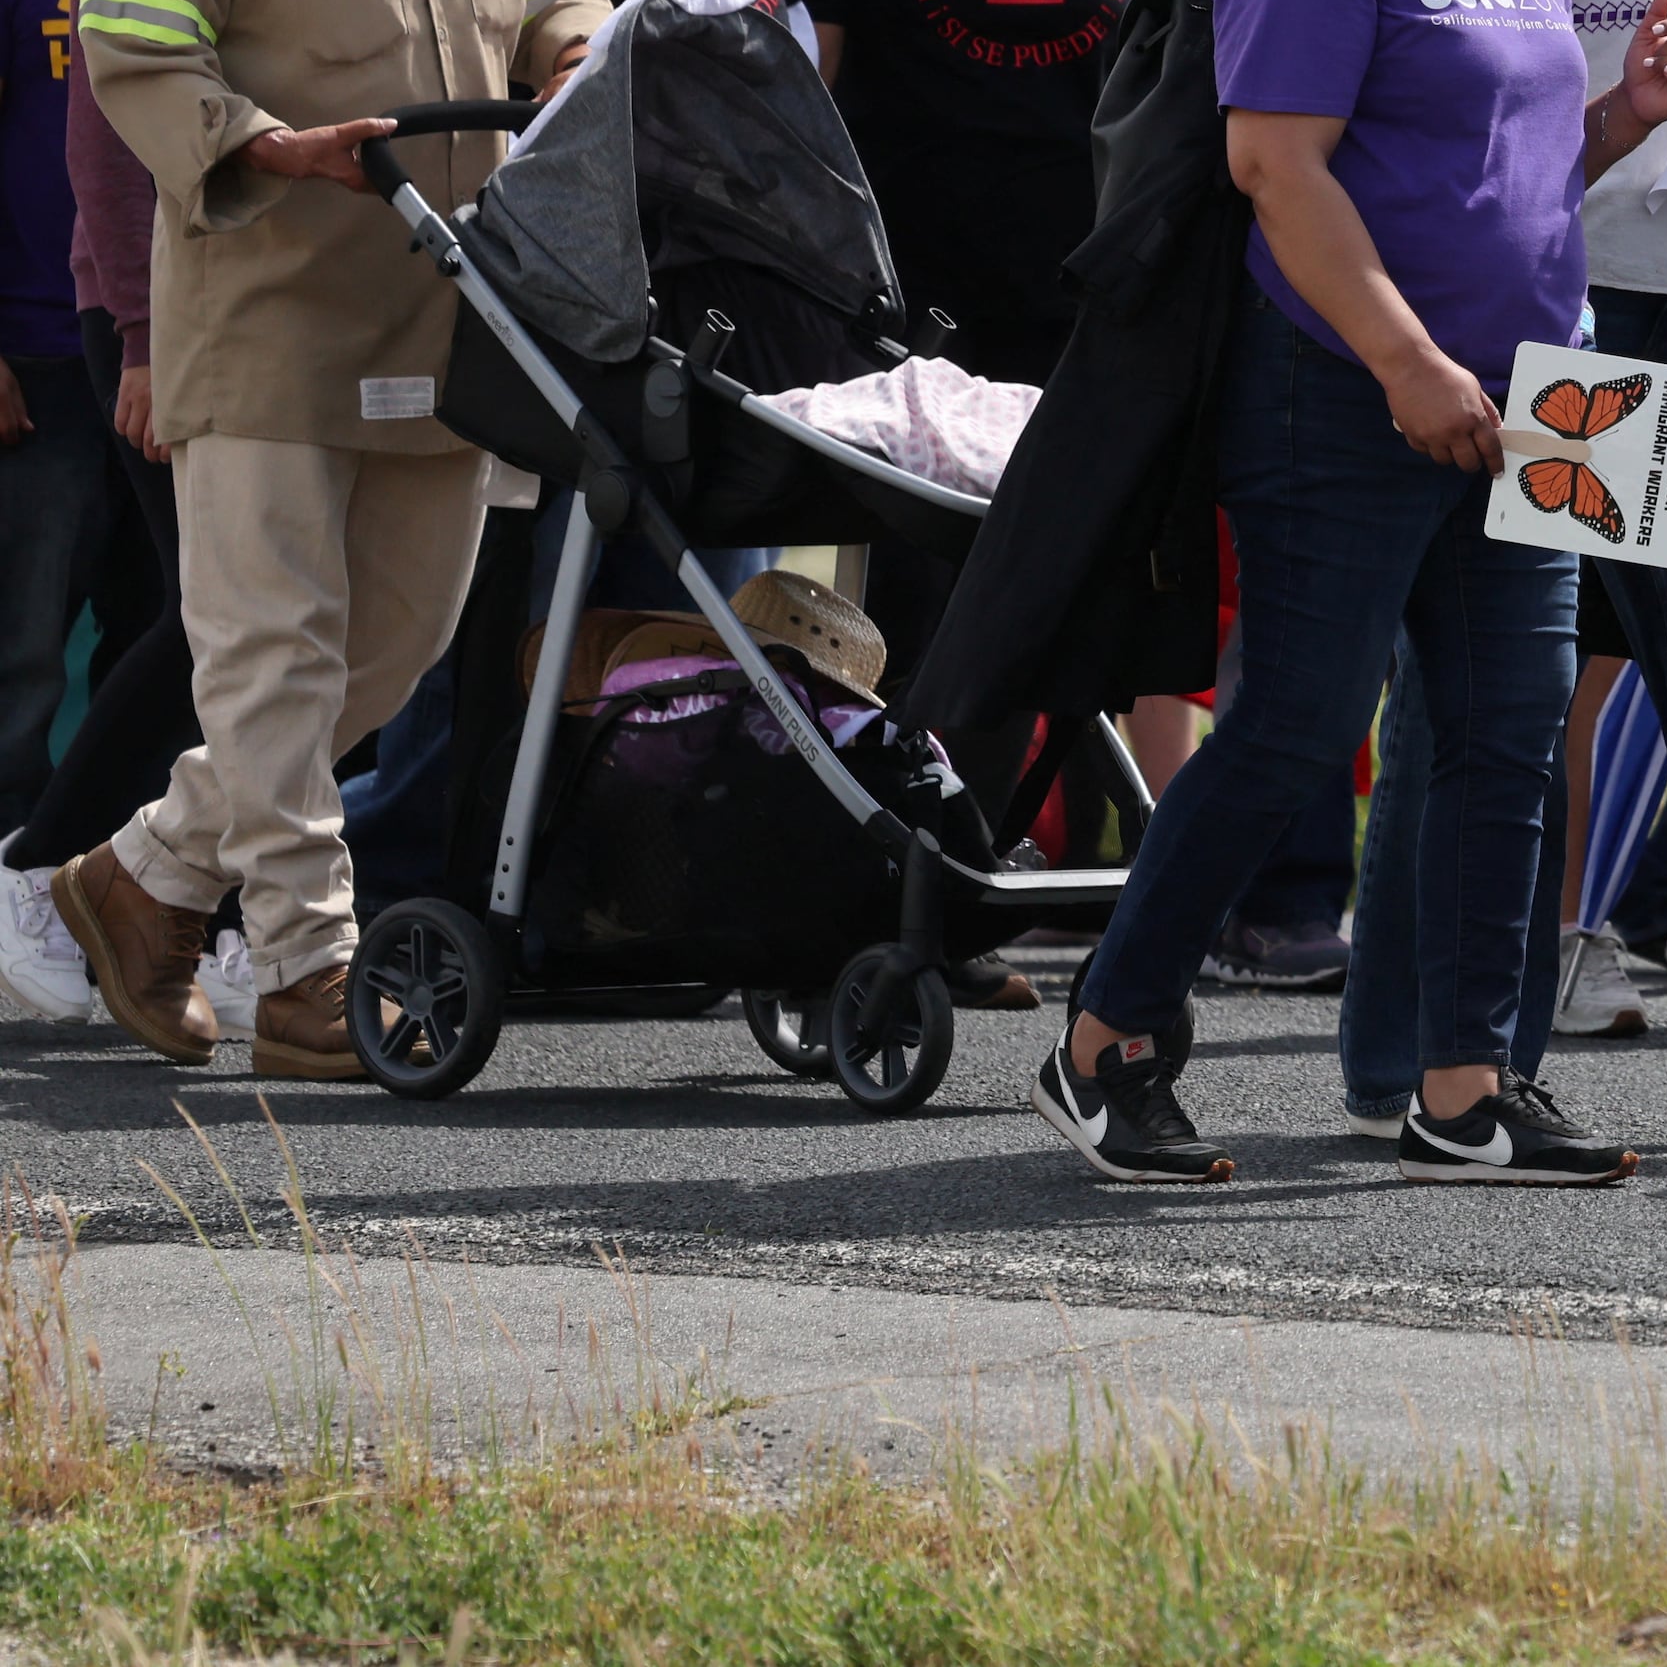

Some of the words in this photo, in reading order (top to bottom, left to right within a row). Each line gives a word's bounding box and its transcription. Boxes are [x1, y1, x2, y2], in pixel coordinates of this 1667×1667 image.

[1430, 14, 1500, 28] California's
[967, 35, 1004, 66] SE
[1636, 469, 1663, 547] WORKERS
[757, 676, 790, 722] OMNI
[786, 718, 820, 763] PLUS
